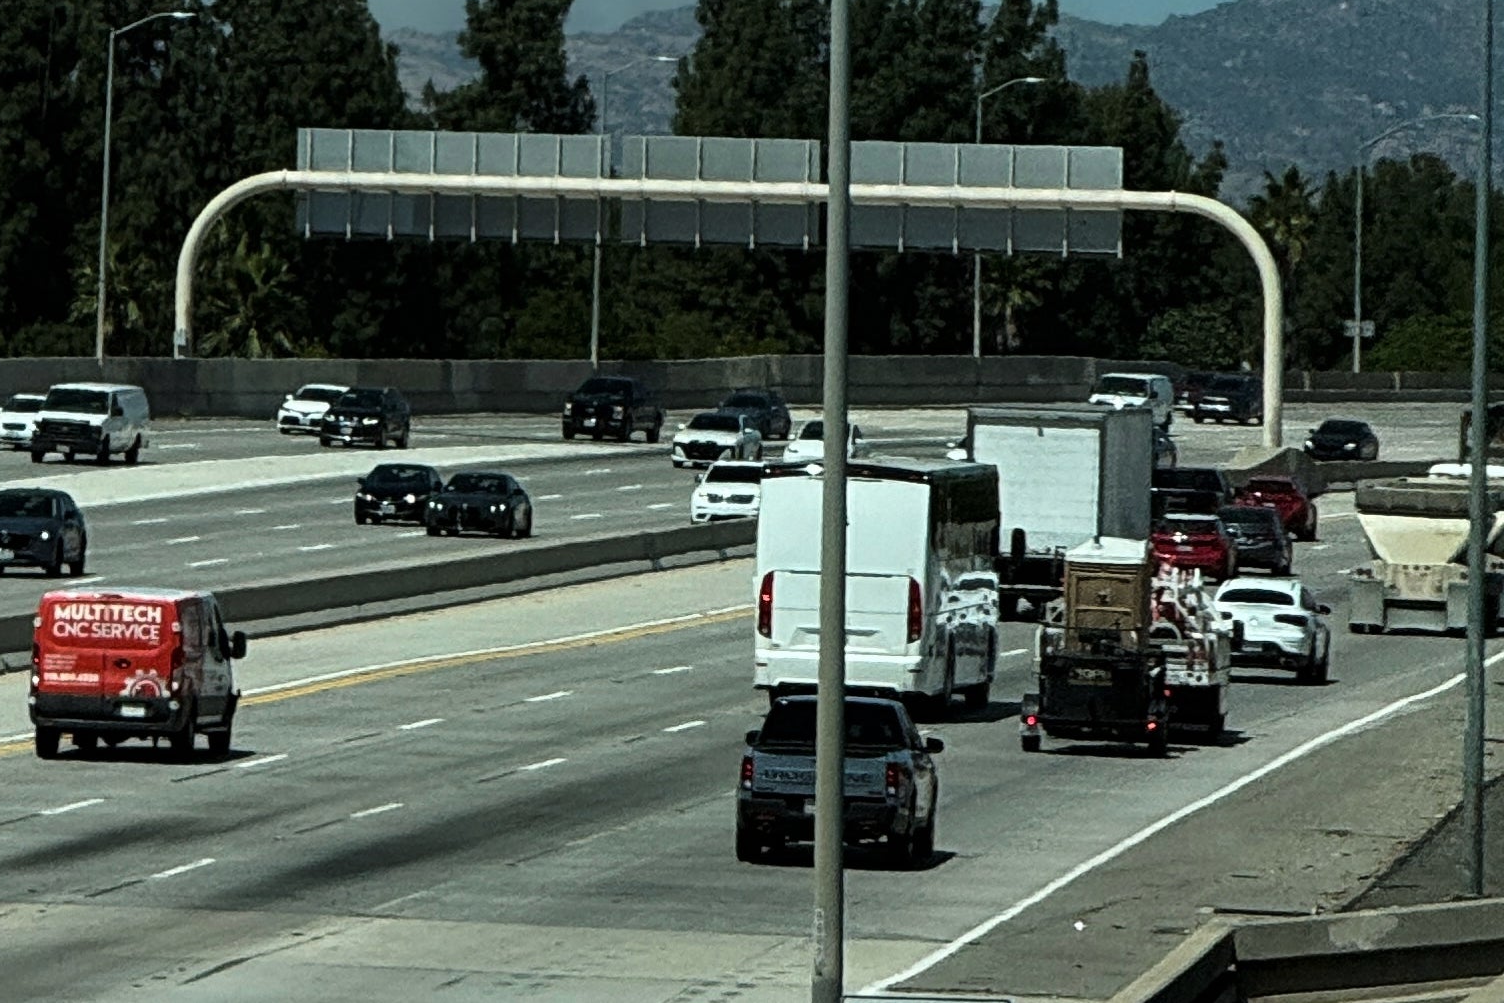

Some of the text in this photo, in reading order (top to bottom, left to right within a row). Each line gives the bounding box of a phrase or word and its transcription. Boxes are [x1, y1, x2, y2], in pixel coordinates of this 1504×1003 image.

[53, 603, 161, 623] MULTITECH
[53, 621, 161, 640] CNC SERVICE
